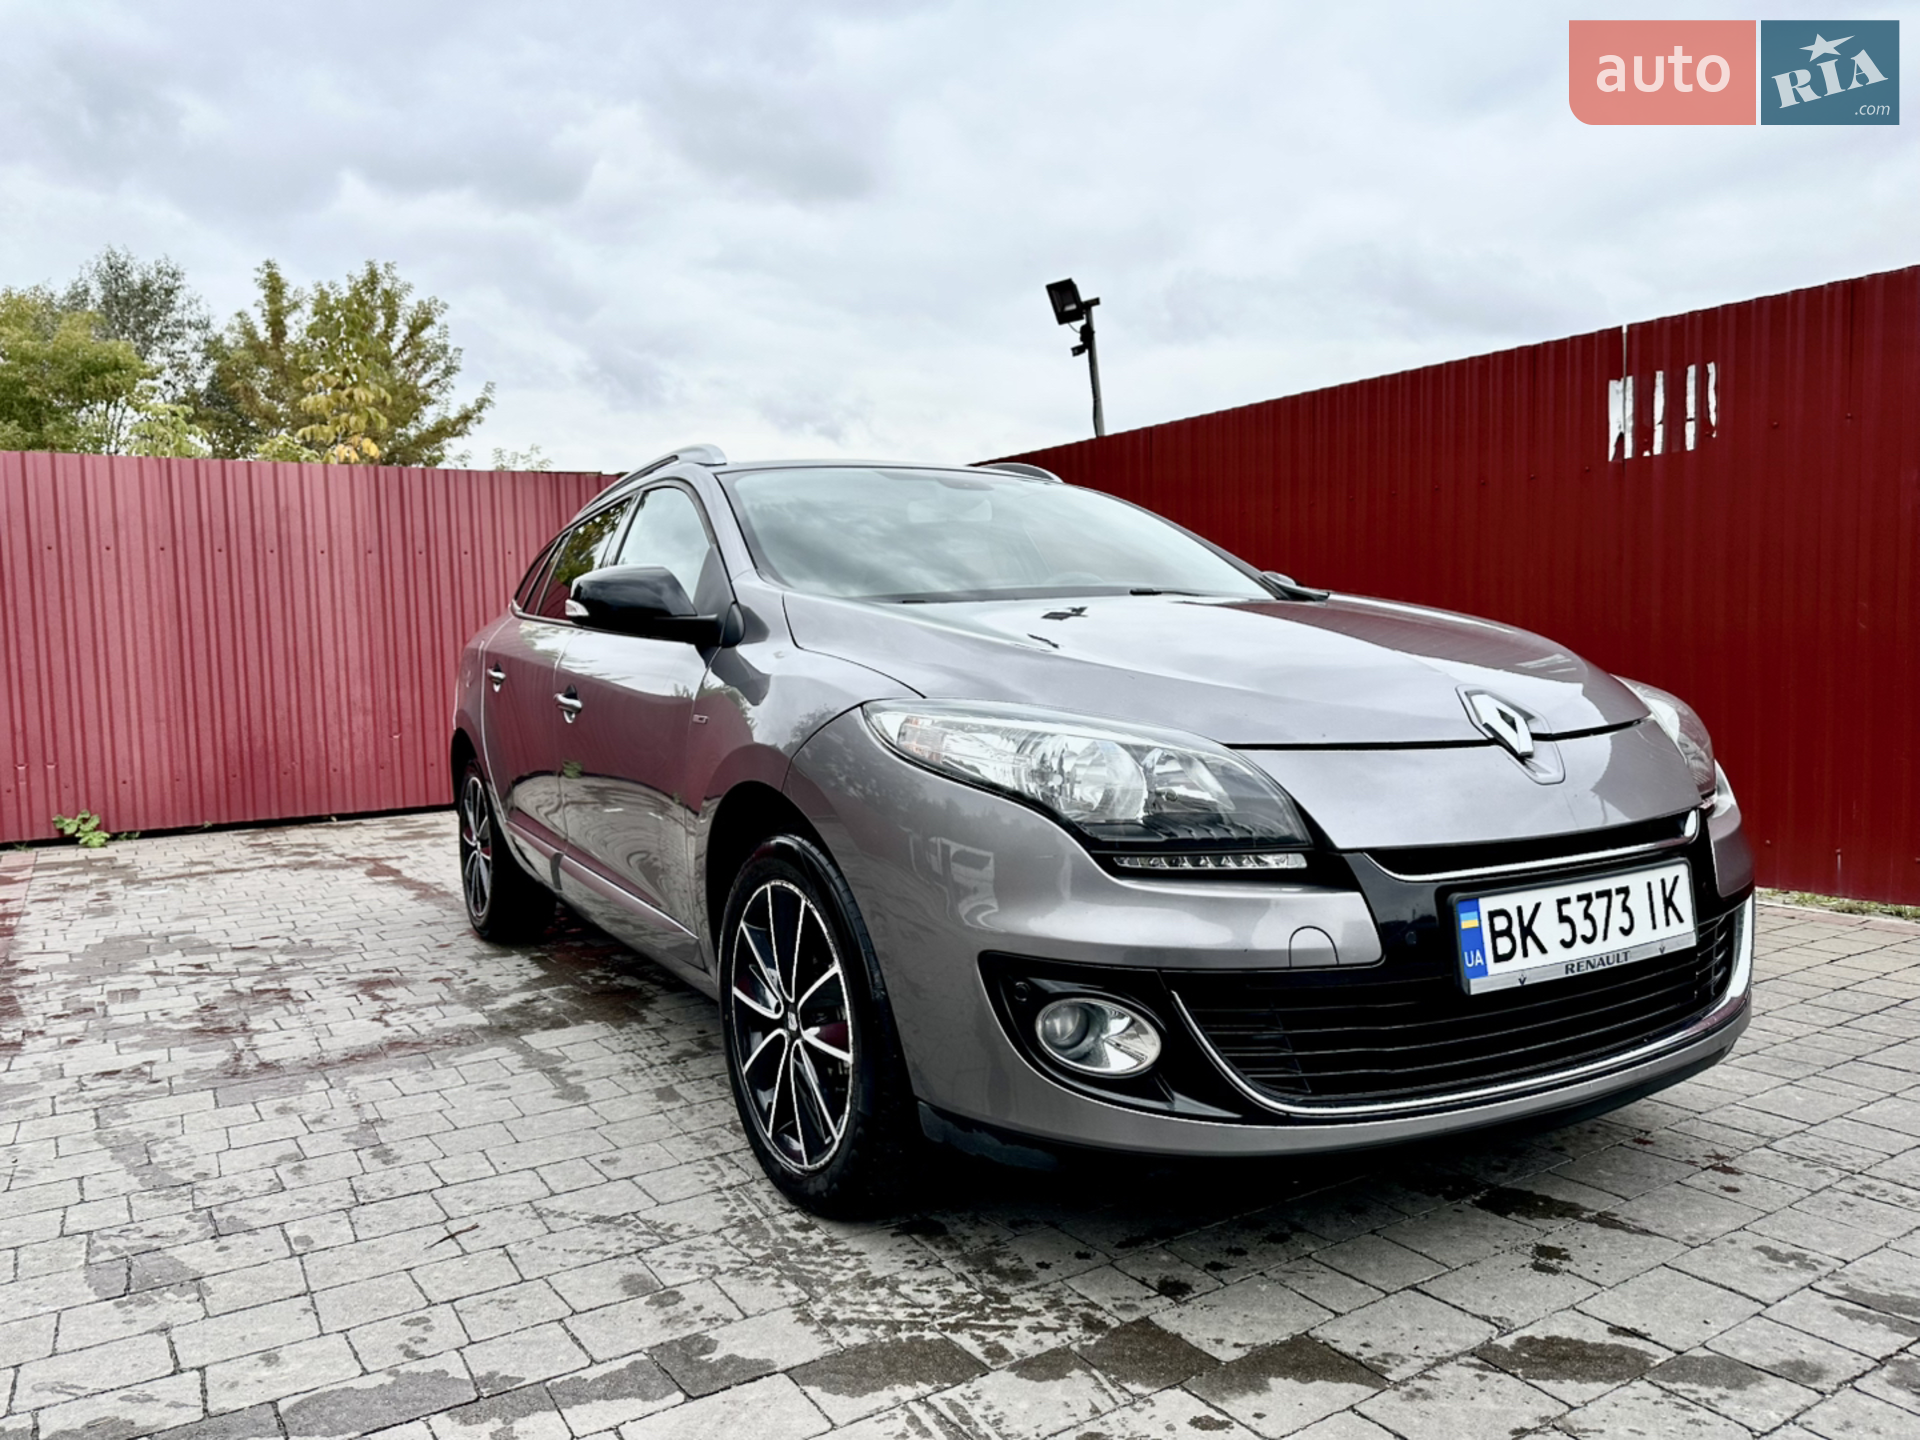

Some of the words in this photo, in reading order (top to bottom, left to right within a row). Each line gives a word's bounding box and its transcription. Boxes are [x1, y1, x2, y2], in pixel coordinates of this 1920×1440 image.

[1487, 901, 1548, 964] BK
[1556, 886, 1635, 949] 5373
[1647, 875, 1684, 930] IK
[1464, 949, 1485, 968] UA
[1564, 950, 1631, 975] RENAULT
